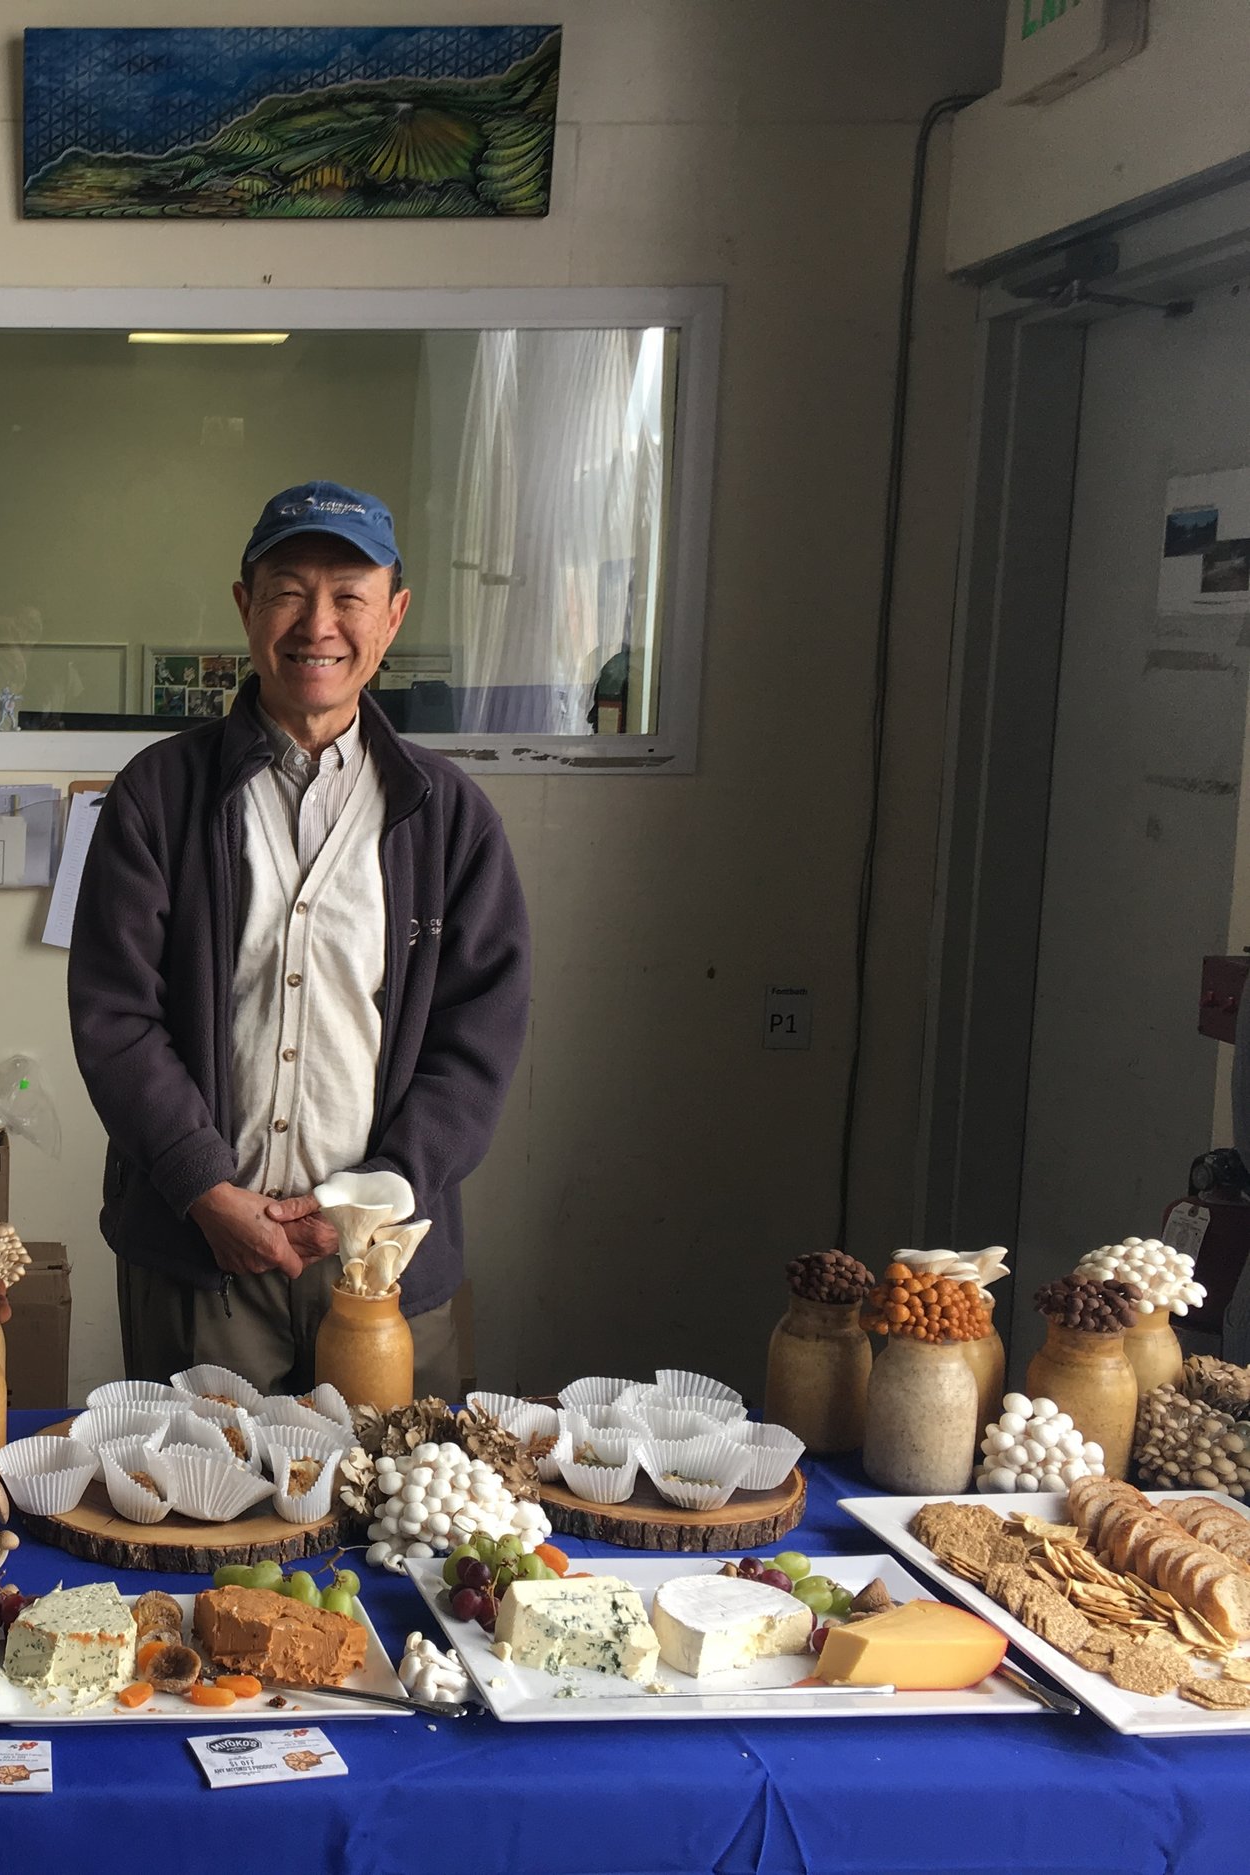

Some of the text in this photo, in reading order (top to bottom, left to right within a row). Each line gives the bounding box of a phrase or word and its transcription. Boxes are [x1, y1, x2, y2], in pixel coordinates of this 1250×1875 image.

[770, 1013, 798, 1034] P1
[241, 1759, 255, 1767] OFF
[252, 1763, 278, 1771] PRODUCT
